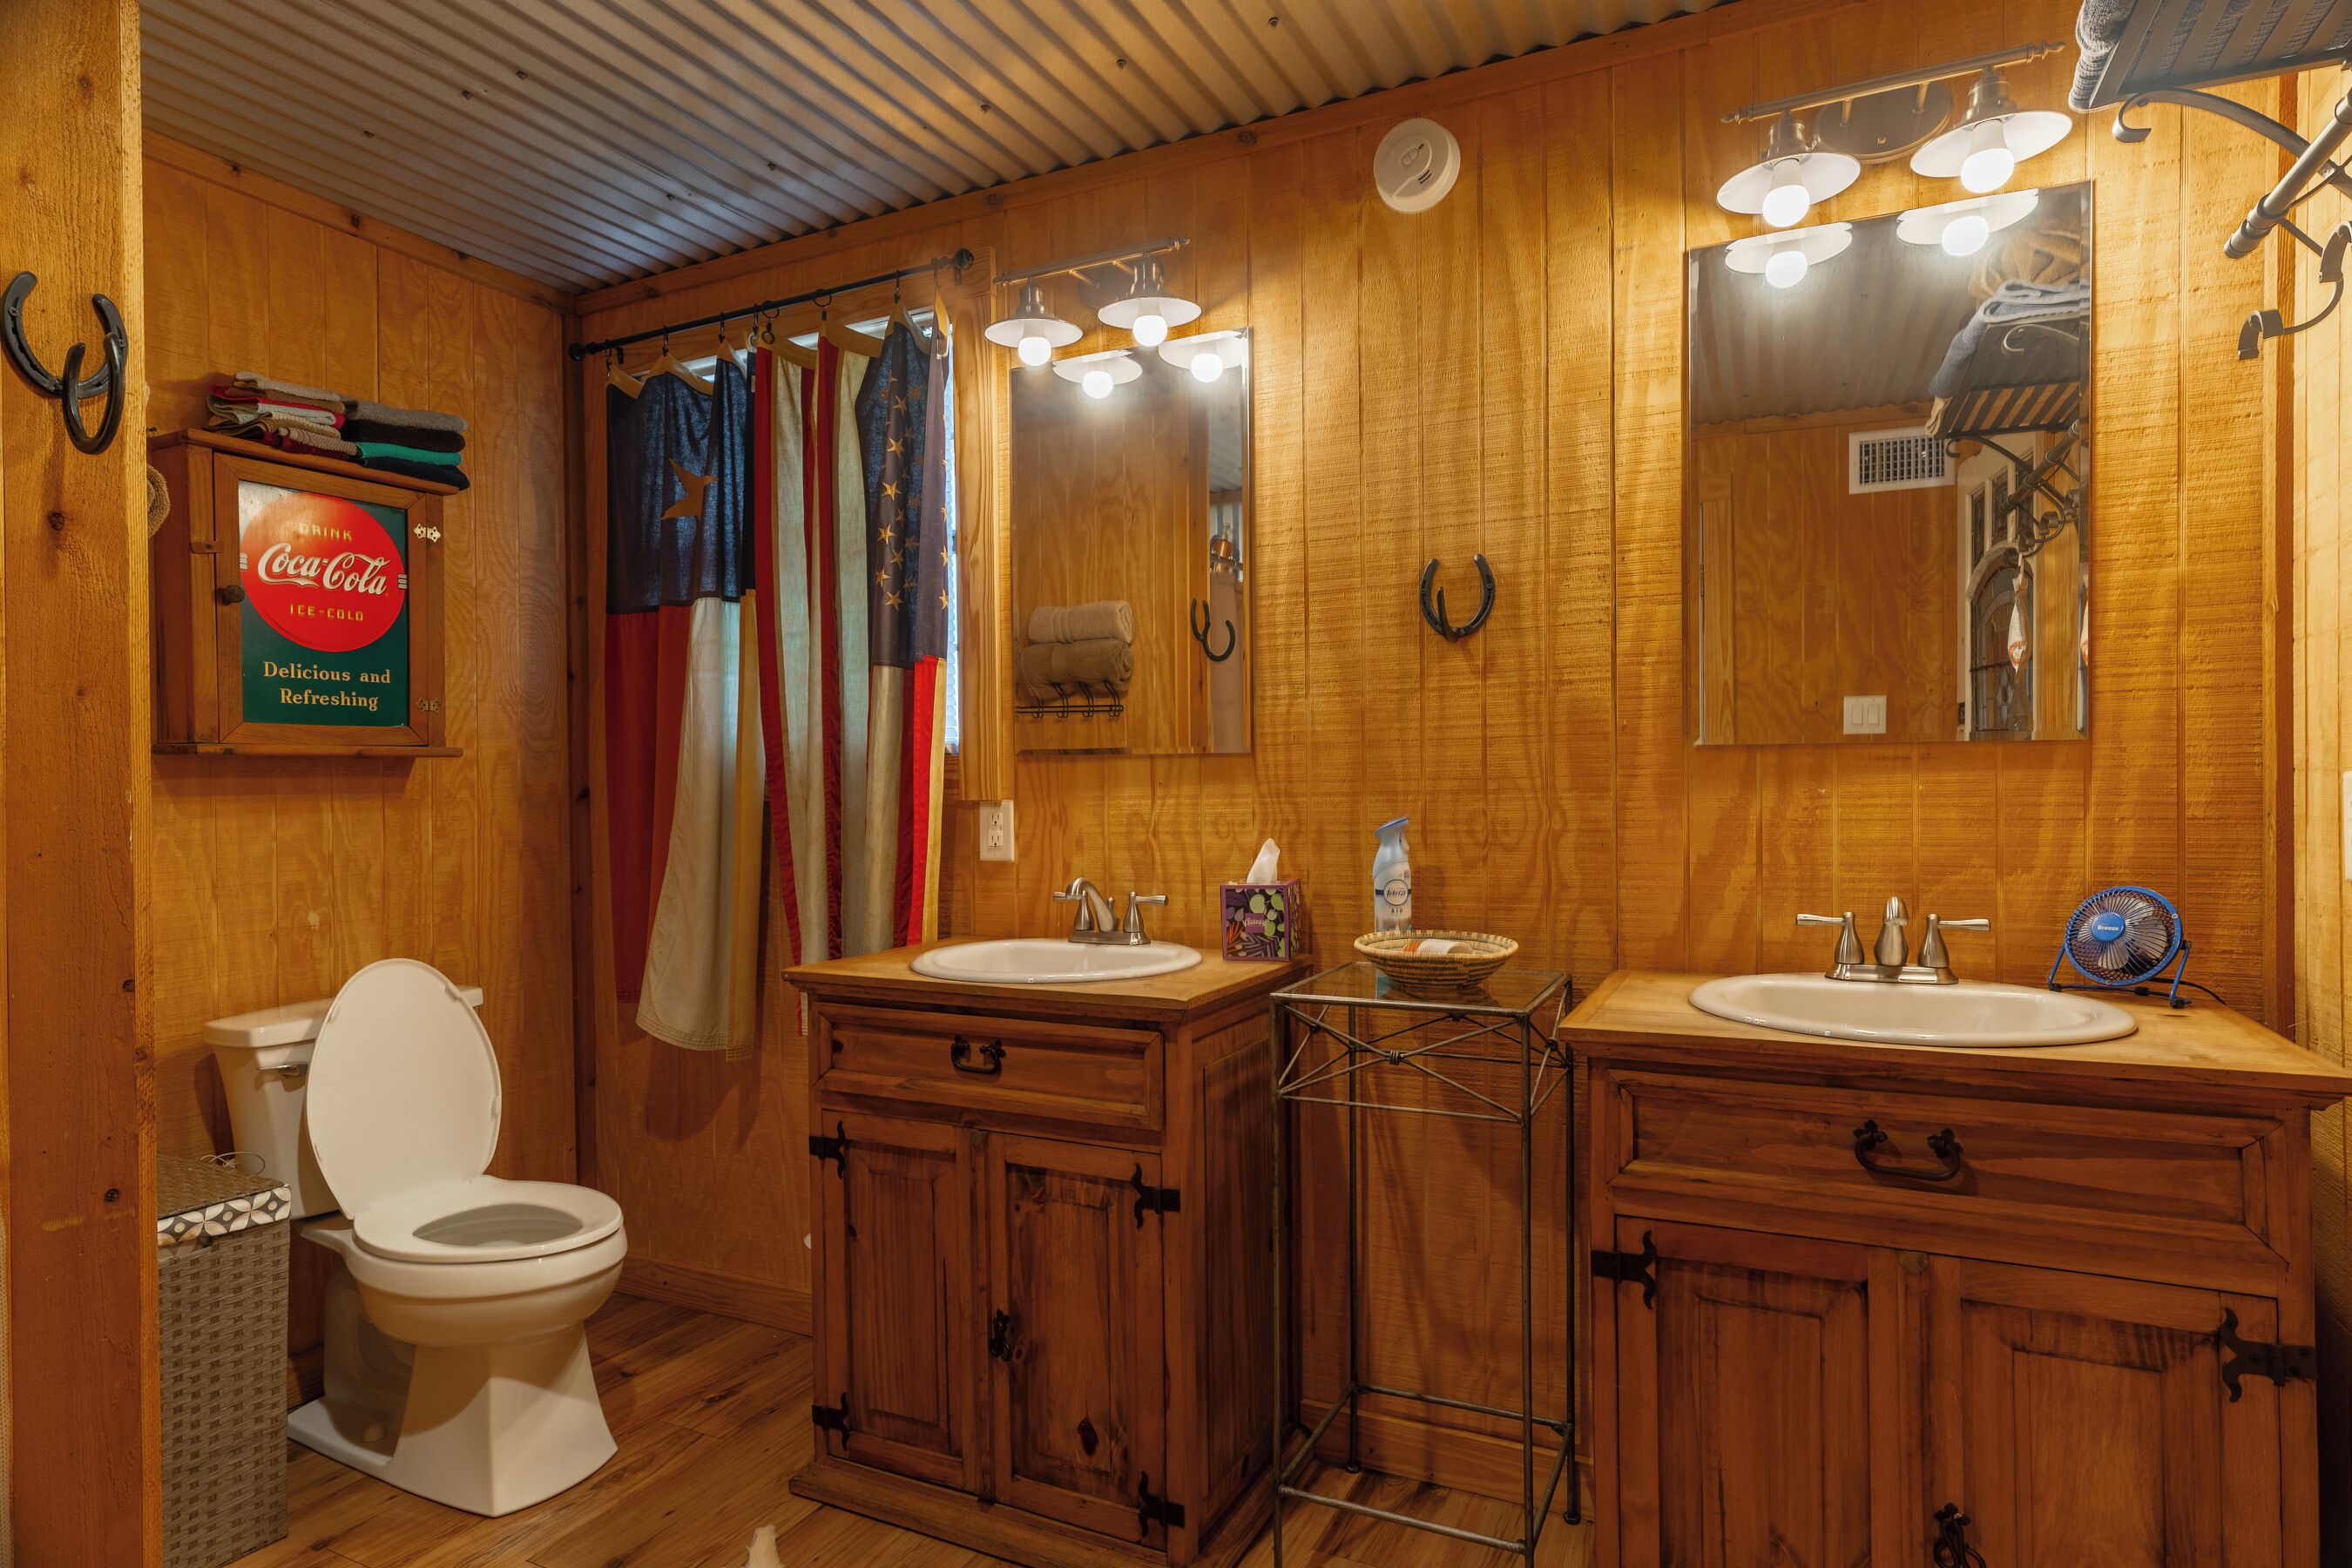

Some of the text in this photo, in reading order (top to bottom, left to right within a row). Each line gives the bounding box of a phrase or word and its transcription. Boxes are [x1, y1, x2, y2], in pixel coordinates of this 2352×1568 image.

[300, 523, 352, 541] DRINK
[258, 543, 391, 595] Coca-Cola
[290, 603, 364, 621] ICE-COLD
[263, 660, 391, 684] Delicious and
[279, 687, 379, 712] Refreshing
